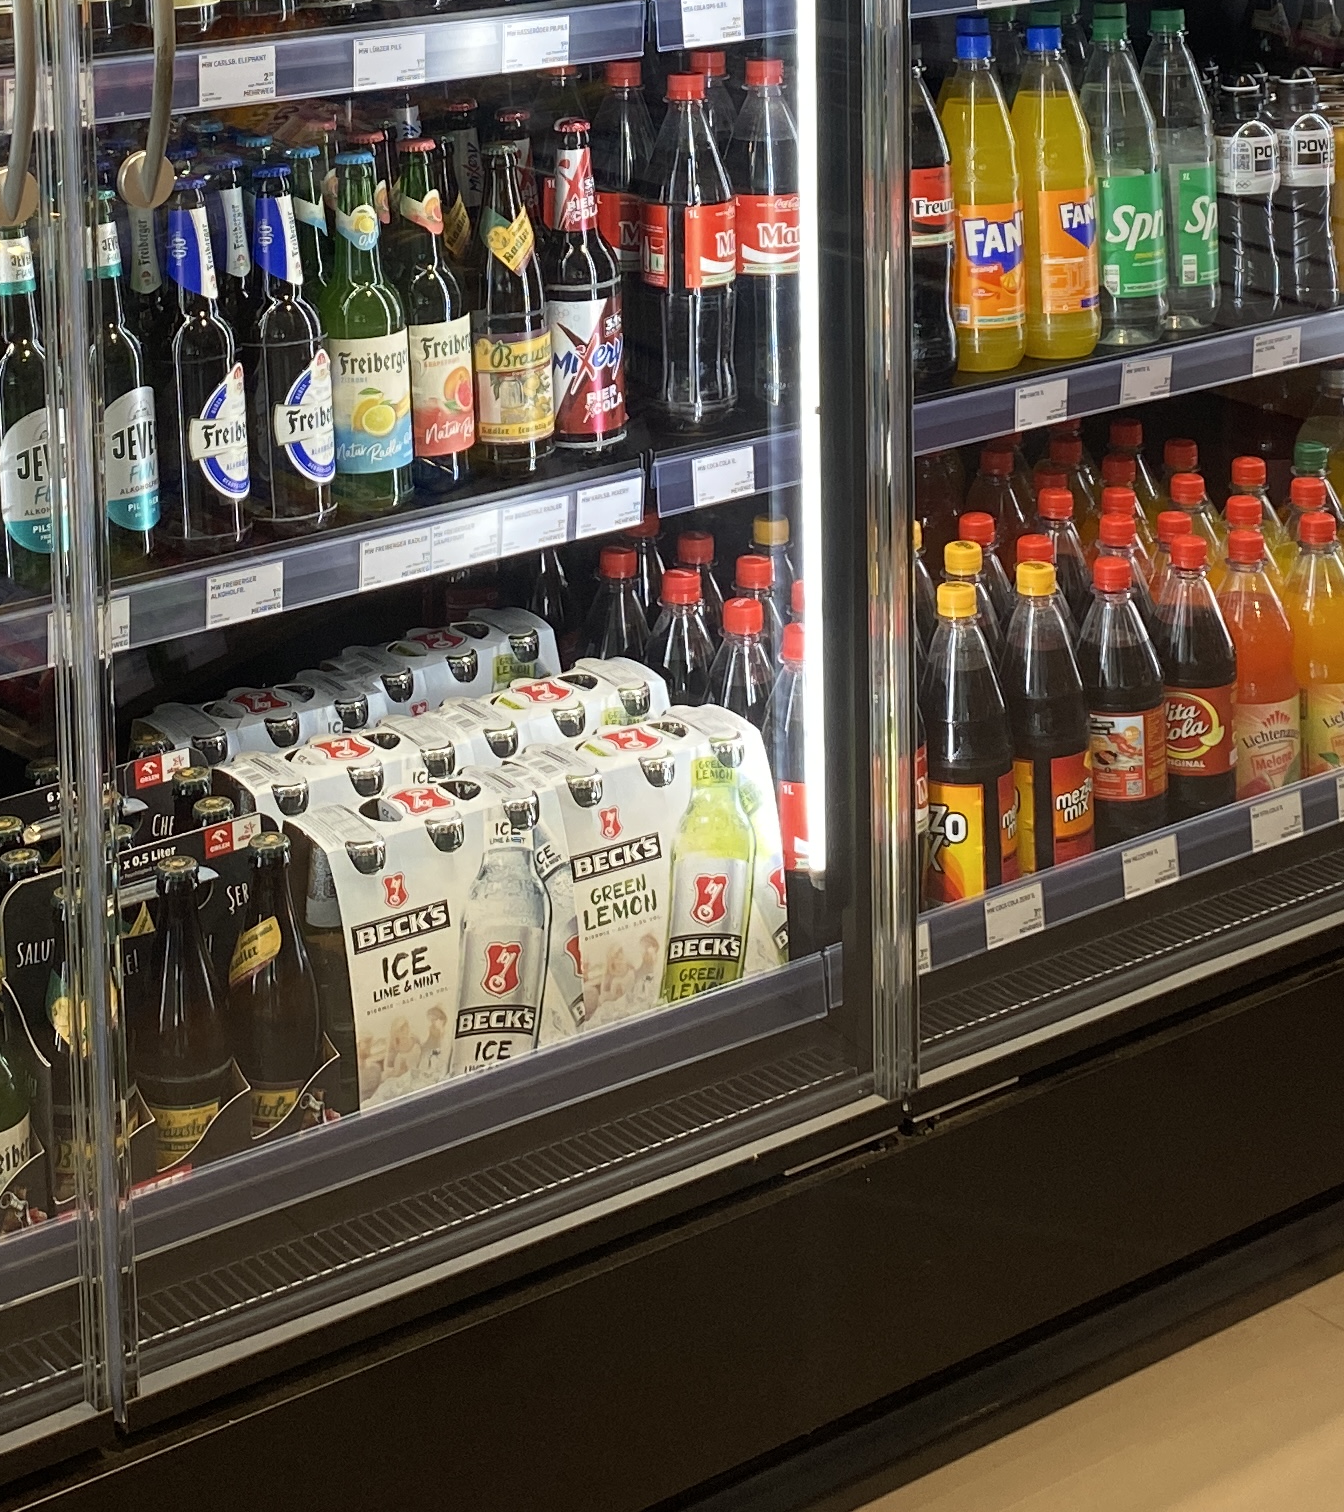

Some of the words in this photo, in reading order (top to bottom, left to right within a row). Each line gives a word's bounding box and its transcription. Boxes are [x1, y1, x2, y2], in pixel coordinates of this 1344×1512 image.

[964, 211, 1024, 258] FAN
[586, 386, 617, 405] BIER
[151, 845, 177, 861] Liter
[572, 832, 662, 882] BECK'S
[590, 874, 648, 906] GREEN
[583, 888, 658, 932] LEMON
[352, 900, 451, 954] BECK'S
[382, 946, 432, 979] ICE
[669, 934, 742, 962] BECK'S
[373, 981, 401, 1003] LIME
[412, 971, 441, 991] MINT
[456, 1004, 536, 1040] BECK'S
